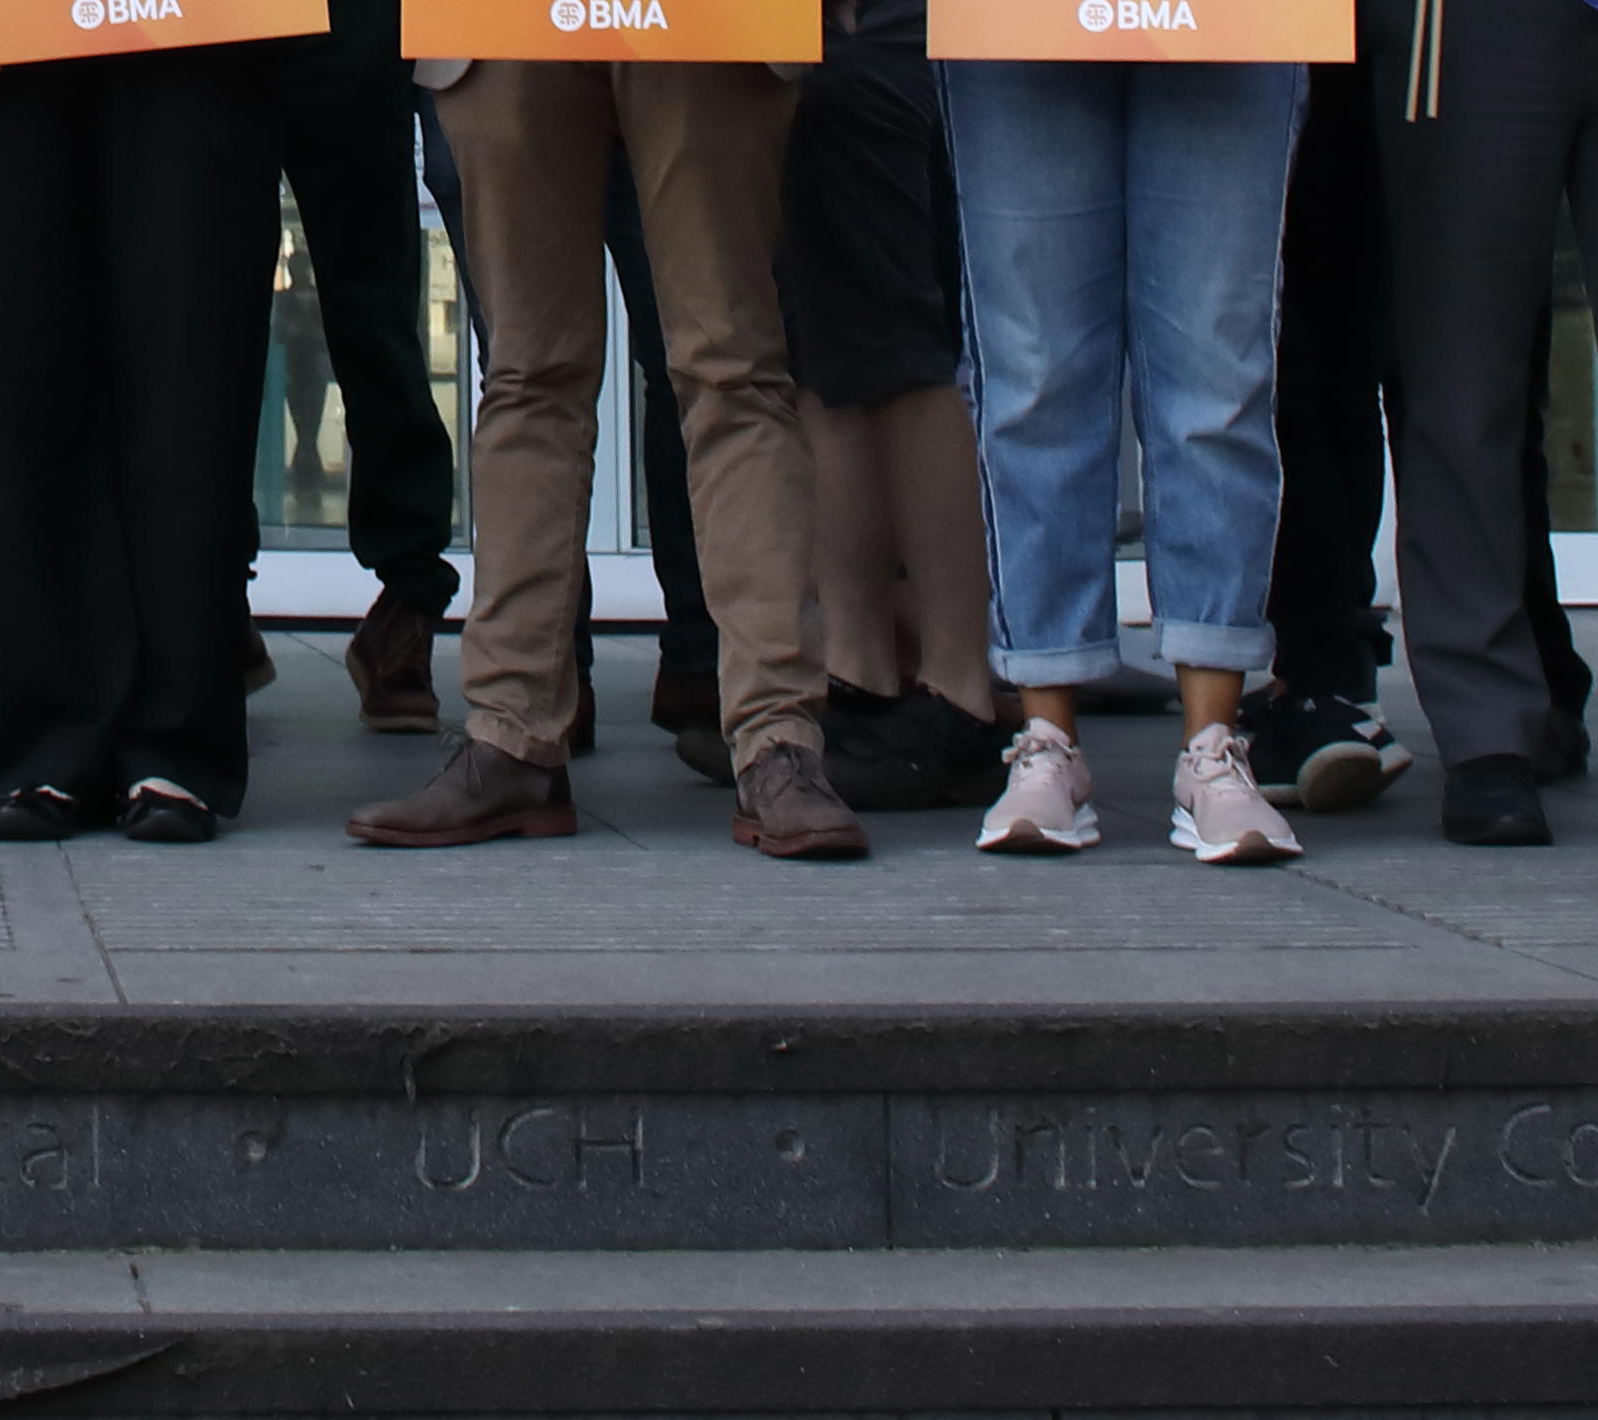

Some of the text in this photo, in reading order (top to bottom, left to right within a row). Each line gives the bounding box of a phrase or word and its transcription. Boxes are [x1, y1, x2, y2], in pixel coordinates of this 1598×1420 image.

[1115, 0, 1197, 30] BMA
[413, 1105, 646, 1193] UCH
[932, 1102, 1458, 1217] University
